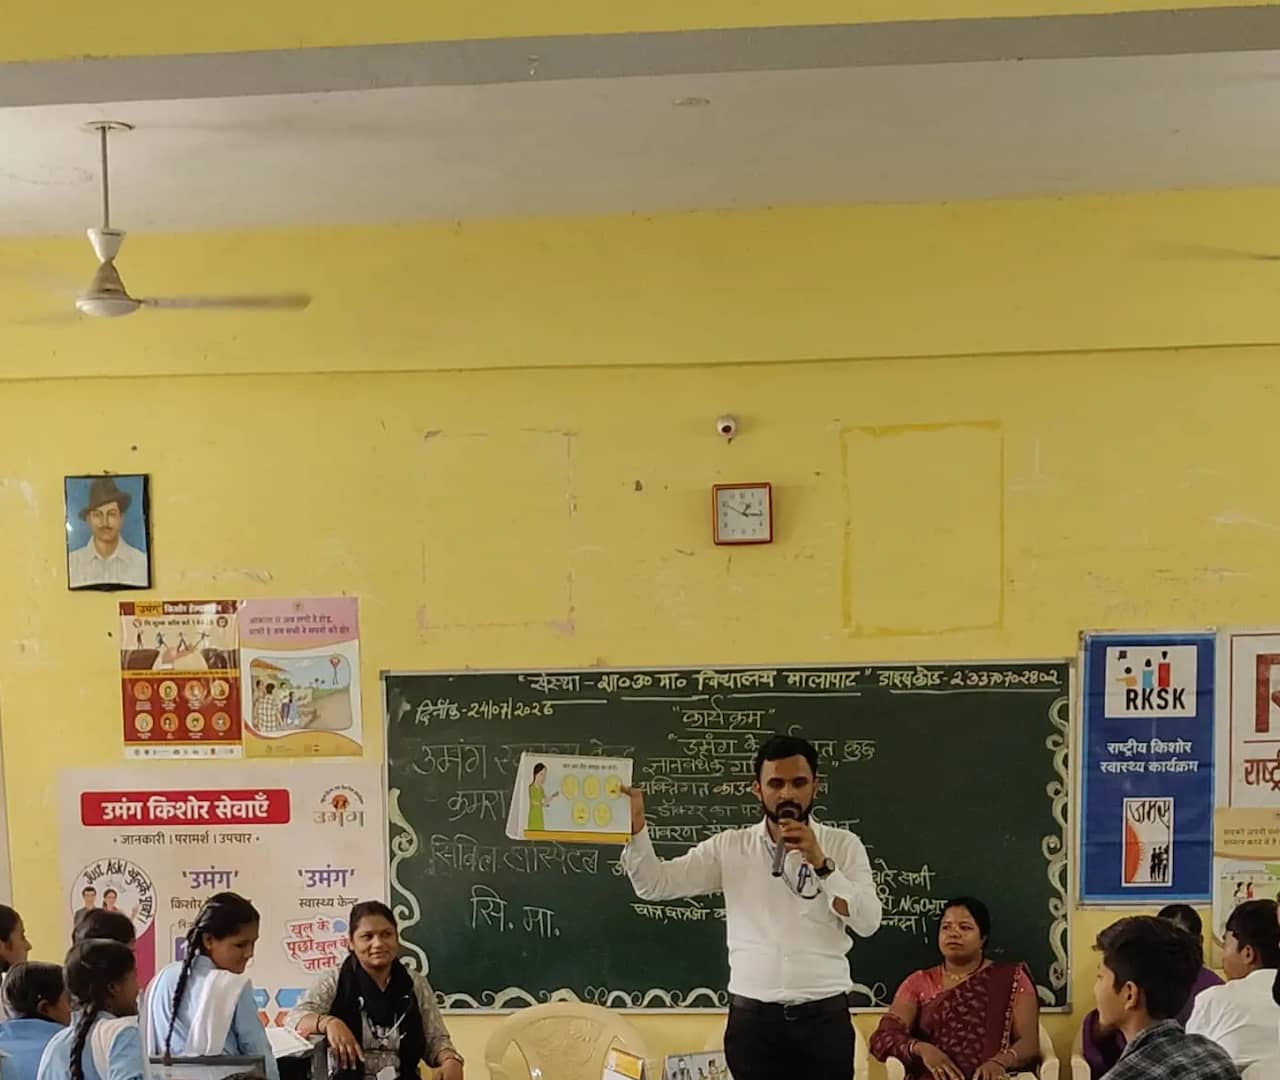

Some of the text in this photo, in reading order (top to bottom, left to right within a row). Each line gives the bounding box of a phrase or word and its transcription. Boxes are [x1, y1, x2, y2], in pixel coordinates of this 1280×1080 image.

[1126, 687, 1186, 711] RKSK
[1107, 738, 1192, 757] राष्ट्रीय किशोर
[1100, 757, 1199, 775] स्वास्थ्य कार्यक्रम
[101, 792, 269, 821] उमंग किशोर सेवाएँ
[120, 829, 252, 846] जानकारी परामर्श उपचार
[83, 863, 105, 885] Just
[171, 896, 202, 910] किशोर
[298, 897, 335, 909] स्वास्थ्य
[290, 917, 330, 937] खुल के
[314, 939, 337, 958] खुल
